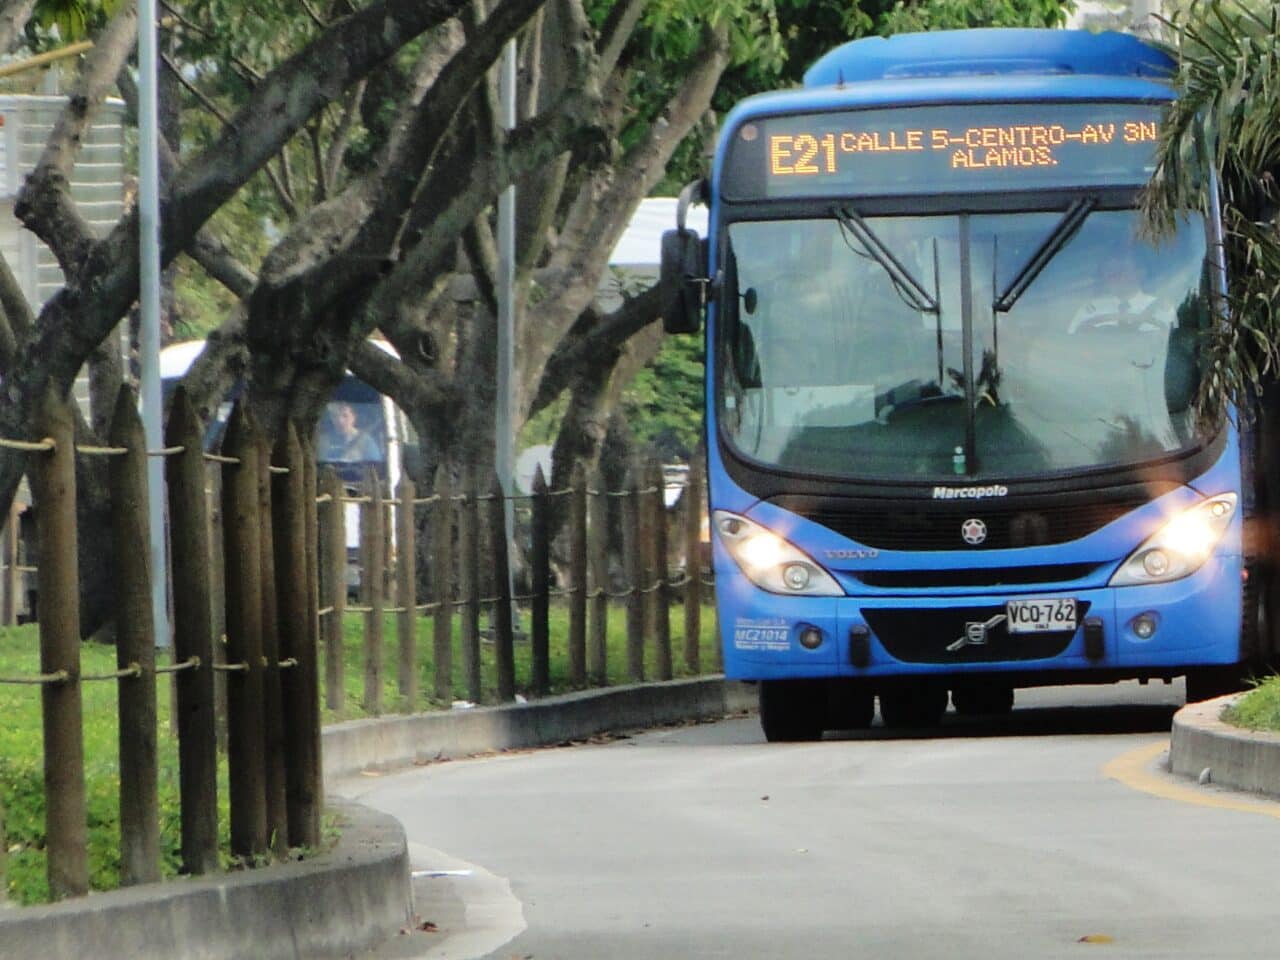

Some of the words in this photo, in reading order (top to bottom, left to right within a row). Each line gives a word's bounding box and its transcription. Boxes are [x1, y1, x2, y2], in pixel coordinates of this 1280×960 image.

[840, 130, 924, 152] CALLE
[770, 133, 836, 175] E21
[952, 146, 1059, 169] ALAMOS.
[932, 485, 1008, 499] Marcopolo
